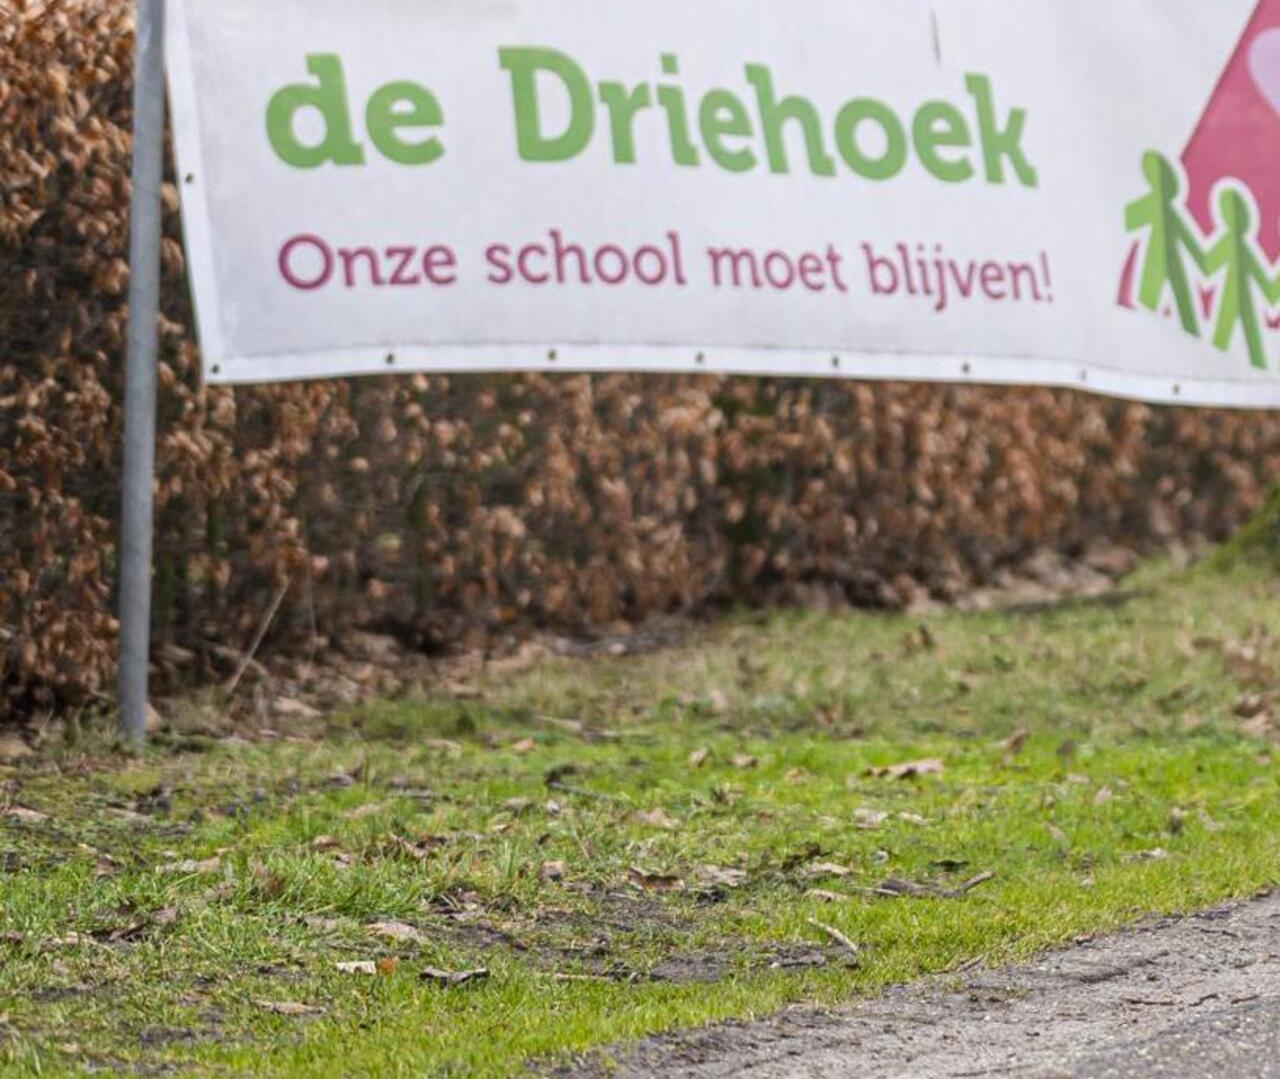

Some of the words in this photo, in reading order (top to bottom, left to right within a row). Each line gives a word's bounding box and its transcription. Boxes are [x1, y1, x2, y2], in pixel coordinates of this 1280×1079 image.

[265, 53, 444, 170] de
[498, 46, 1038, 188] Driehoek
[277, 232, 457, 292] Onze
[485, 229, 687, 287] school
[706, 245, 848, 294] moet
[863, 241, 1056, 314] blijven!
